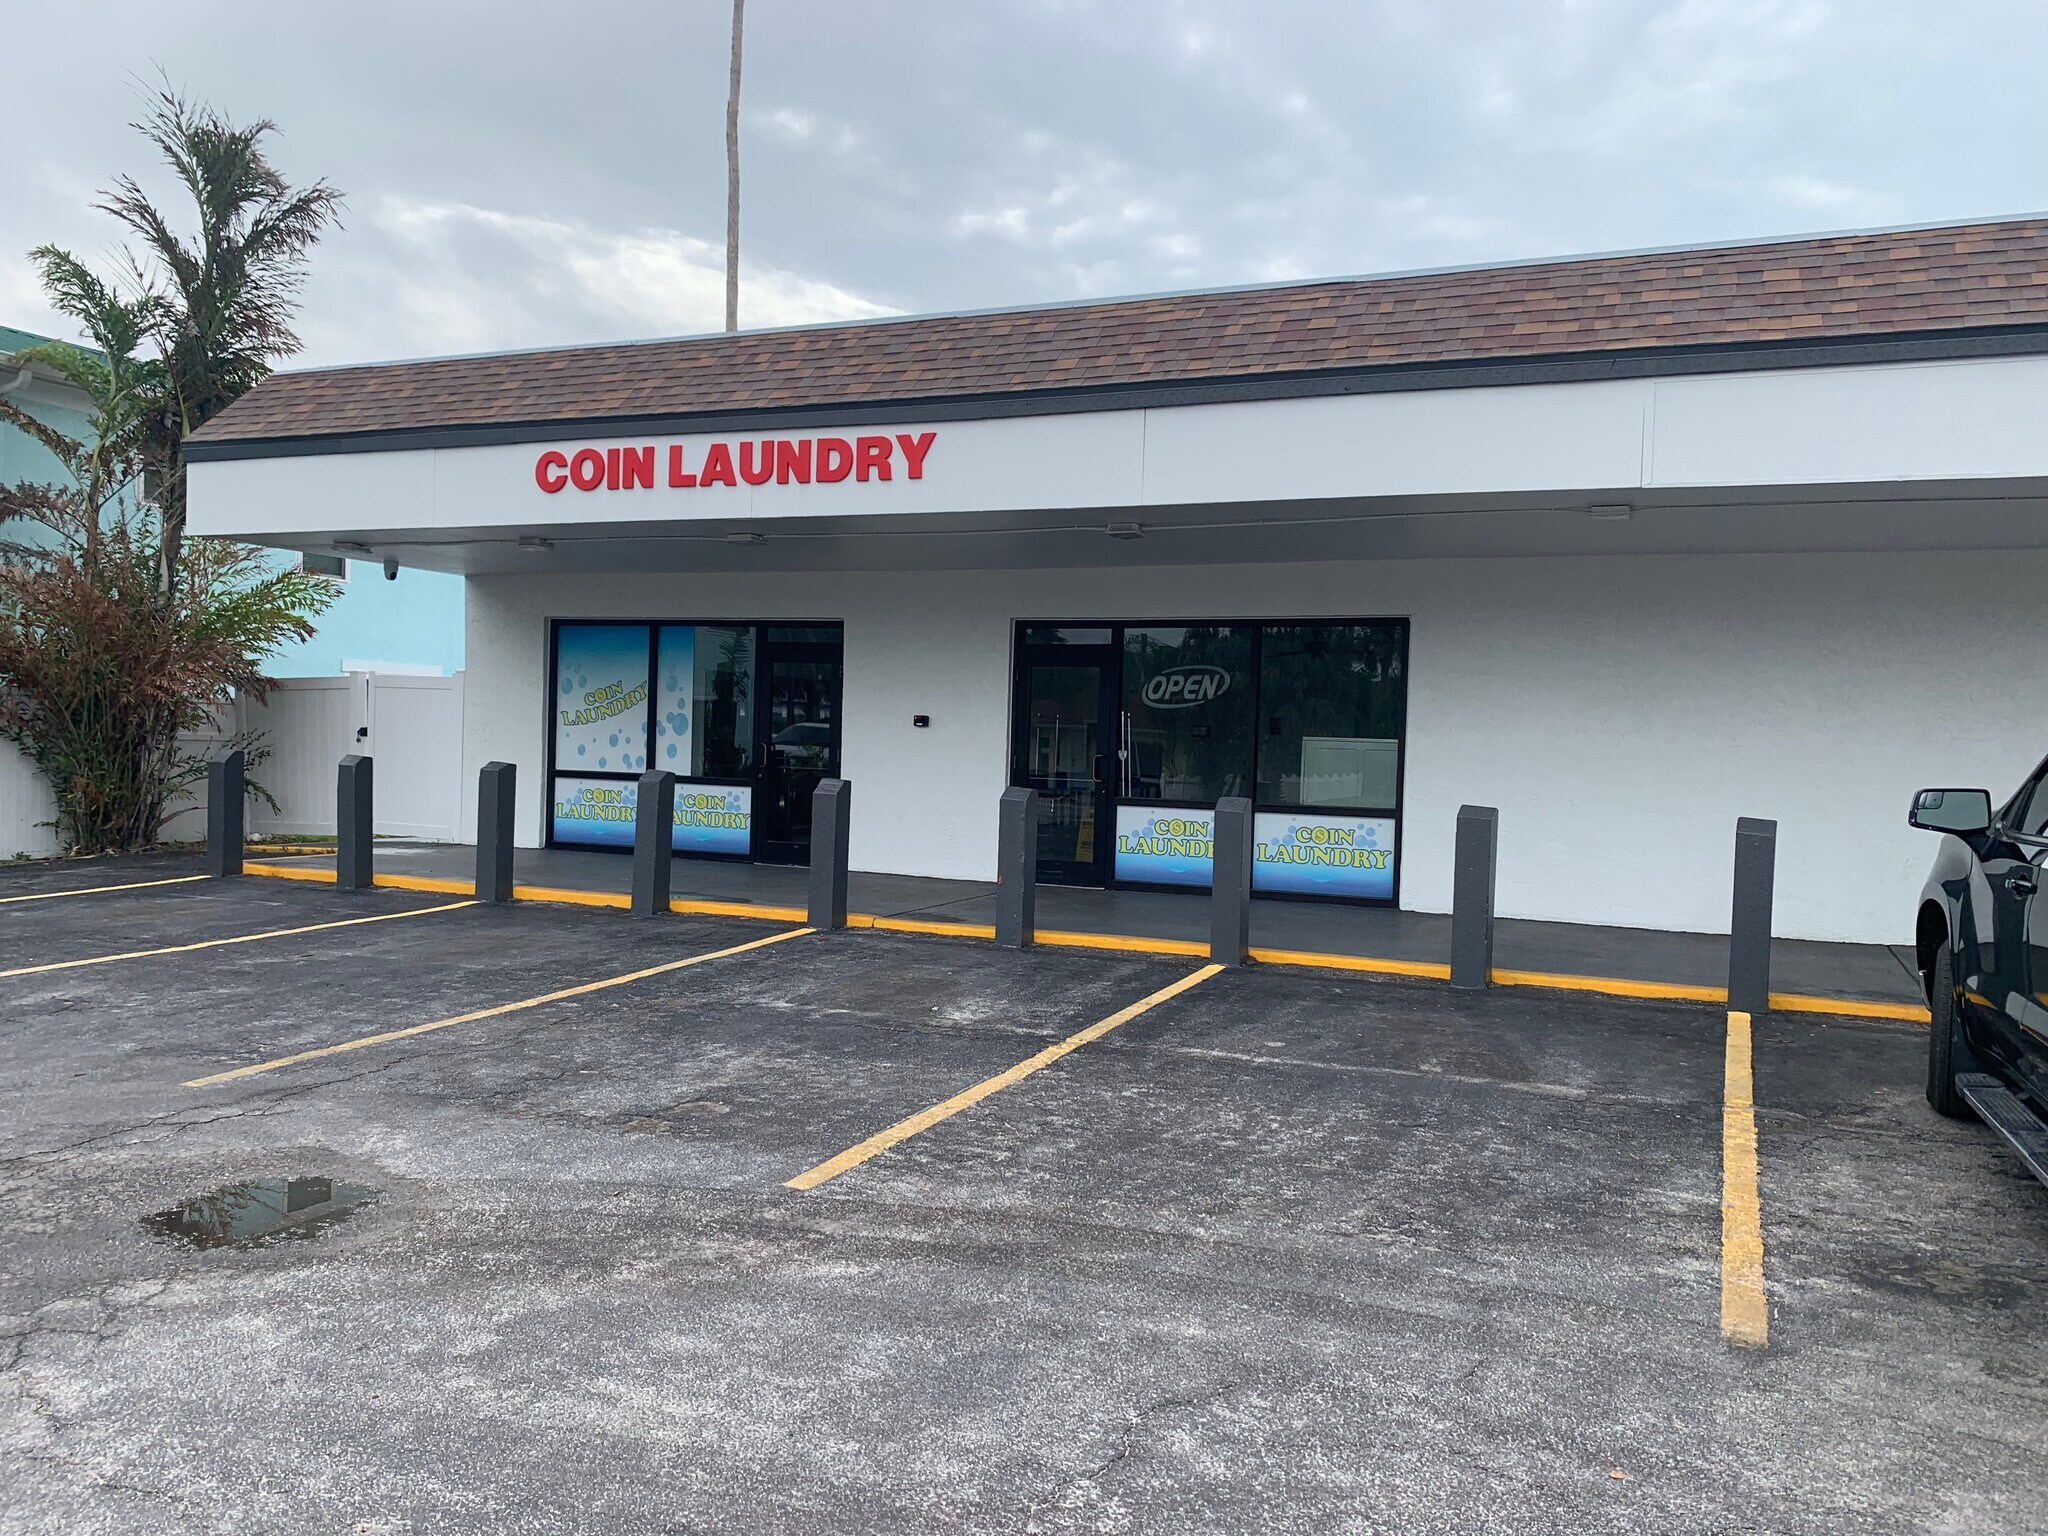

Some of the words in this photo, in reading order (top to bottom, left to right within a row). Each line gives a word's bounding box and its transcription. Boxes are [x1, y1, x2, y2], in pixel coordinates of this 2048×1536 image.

[535, 446, 655, 493] COIN
[668, 432, 937, 487] LAUNDRY
[584, 680, 623, 706] COIN
[1147, 674, 1220, 700] OPEN
[561, 681, 648, 726] LAUNDRY
[582, 788, 622, 804] COIN
[684, 794, 726, 810] COIN
[672, 809, 750, 830] AUNDRY
[1154, 818, 1209, 837] COIN
[1119, 835, 1215, 858] LAUND
[1295, 826, 1355, 846] COIN
[1256, 843, 1392, 869] LAUNDRY
